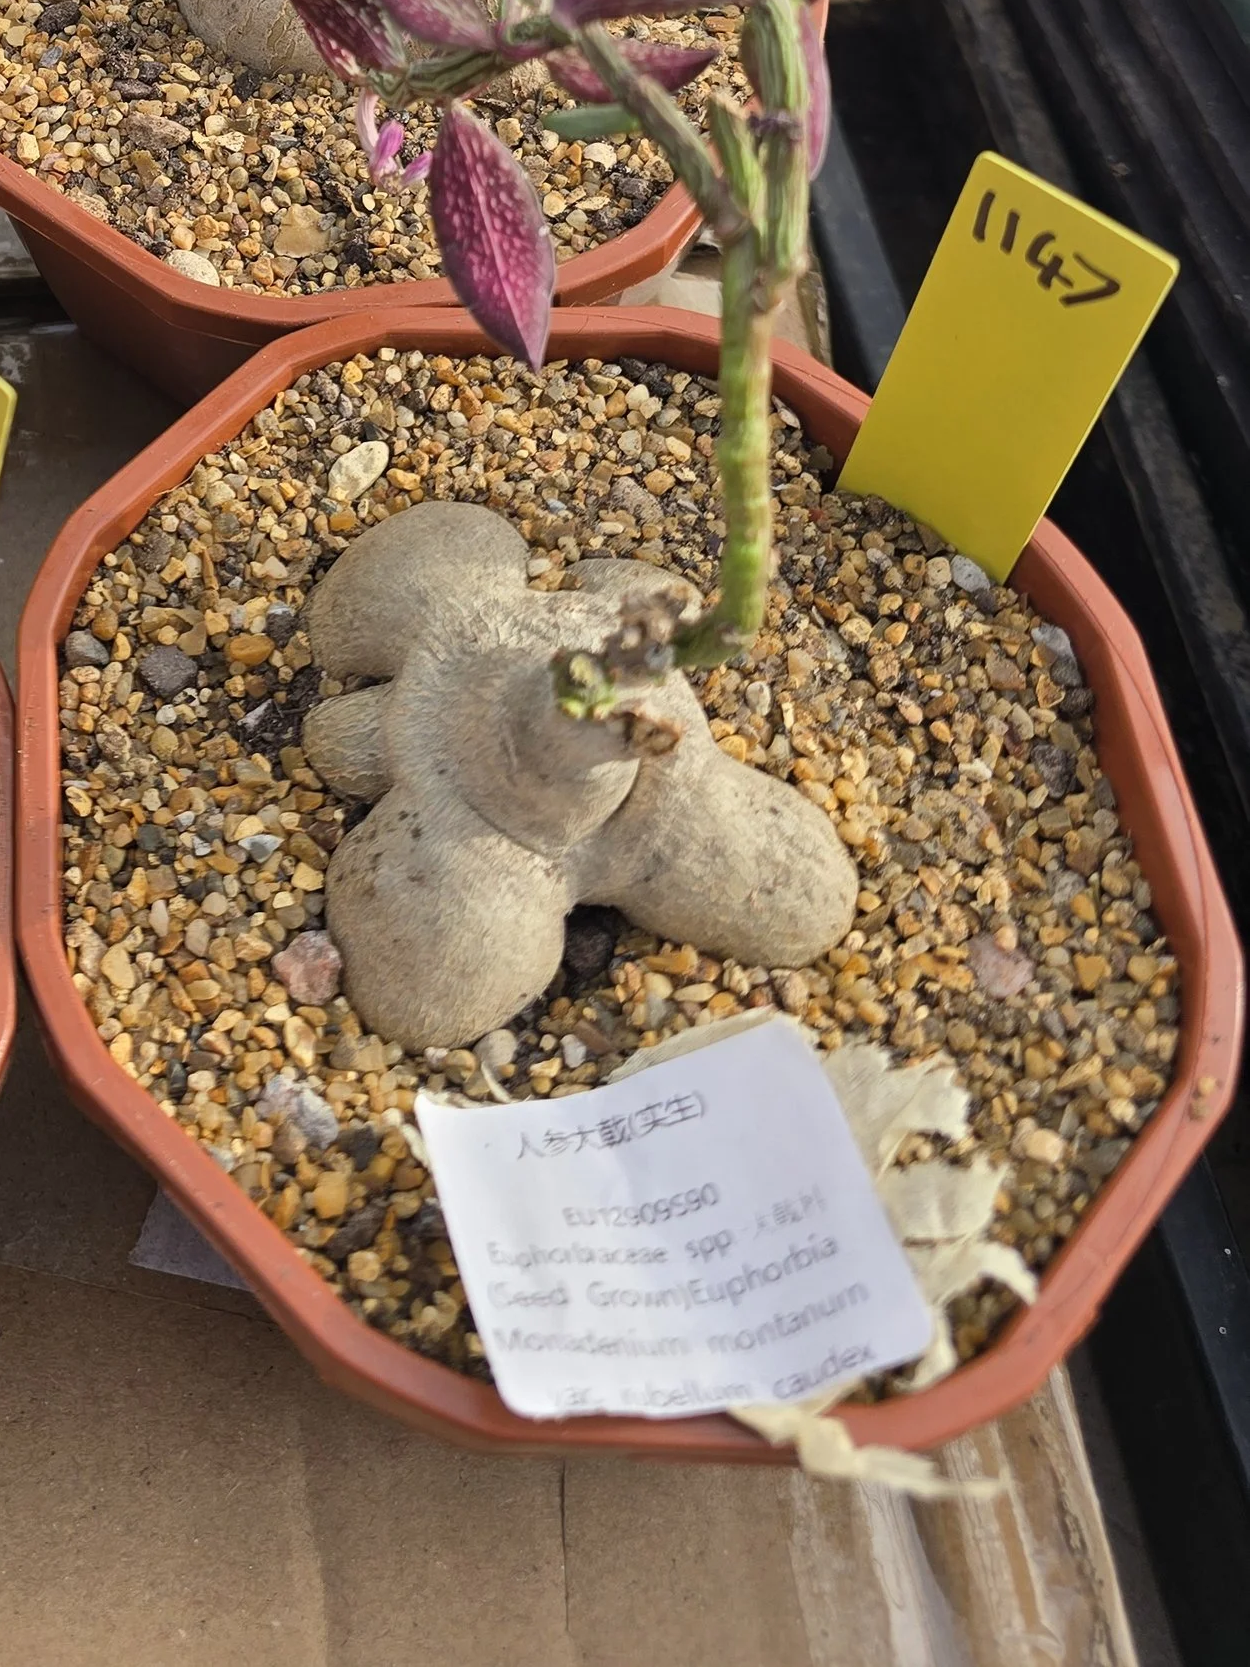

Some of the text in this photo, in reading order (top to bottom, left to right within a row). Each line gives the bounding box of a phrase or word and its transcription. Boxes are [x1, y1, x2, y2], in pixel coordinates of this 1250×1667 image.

[972, 189, 1121, 308] 1147
[706, 1282, 871, 1355] montanum
[772, 1342, 877, 1401] caudex
